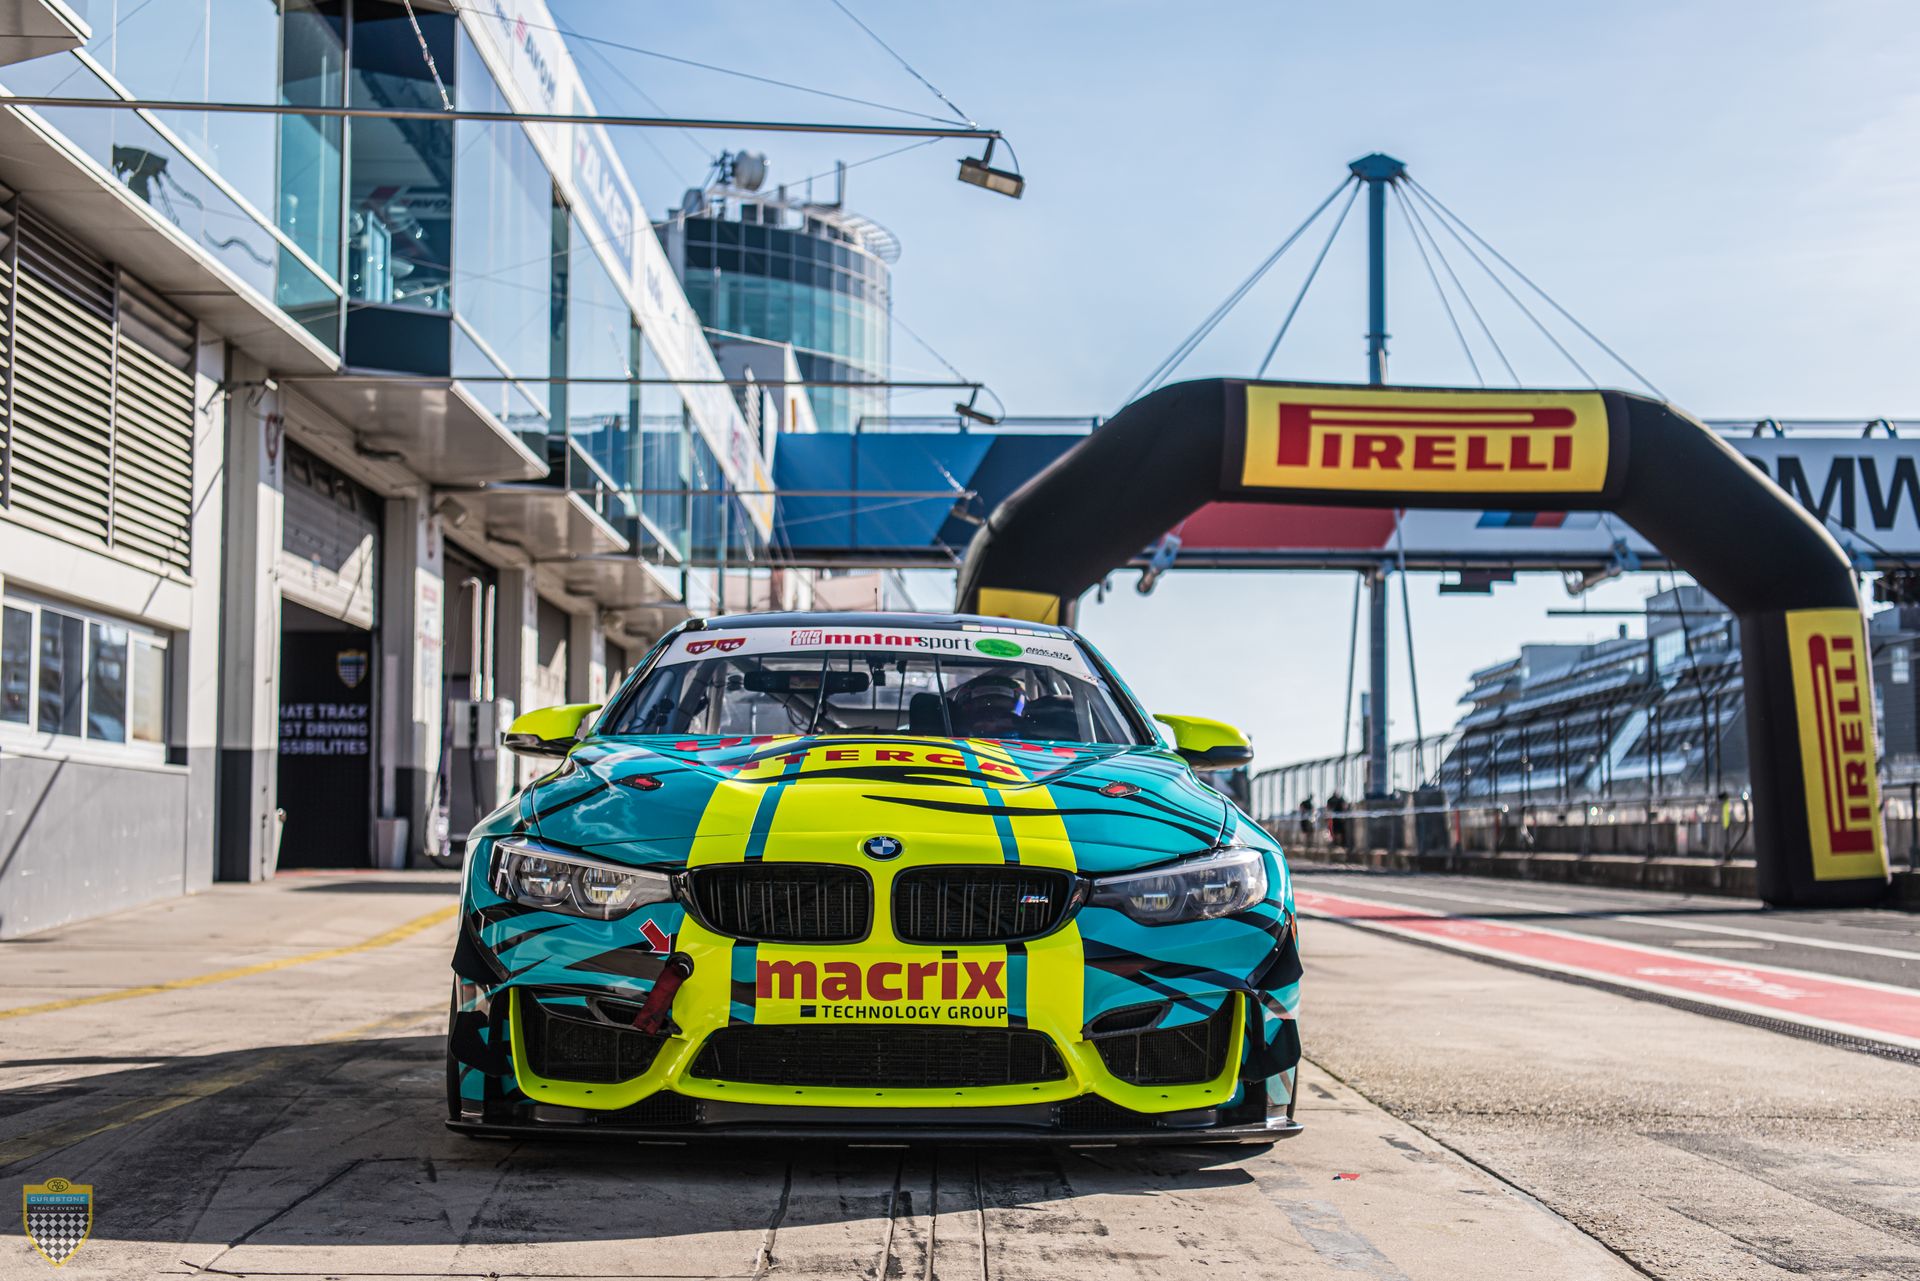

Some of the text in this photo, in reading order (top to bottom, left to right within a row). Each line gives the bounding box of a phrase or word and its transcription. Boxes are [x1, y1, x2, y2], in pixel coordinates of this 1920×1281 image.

[1277, 402, 1577, 472] PIRELLI
[280, 704, 367, 718] ATE TRACK
[306, 722, 368, 737] DRIVING
[1808, 633, 1875, 855] PIRELLI
[756, 950, 1006, 1002] macrix
[821, 1005, 1009, 1020] TECHNOLOGY GROUP
